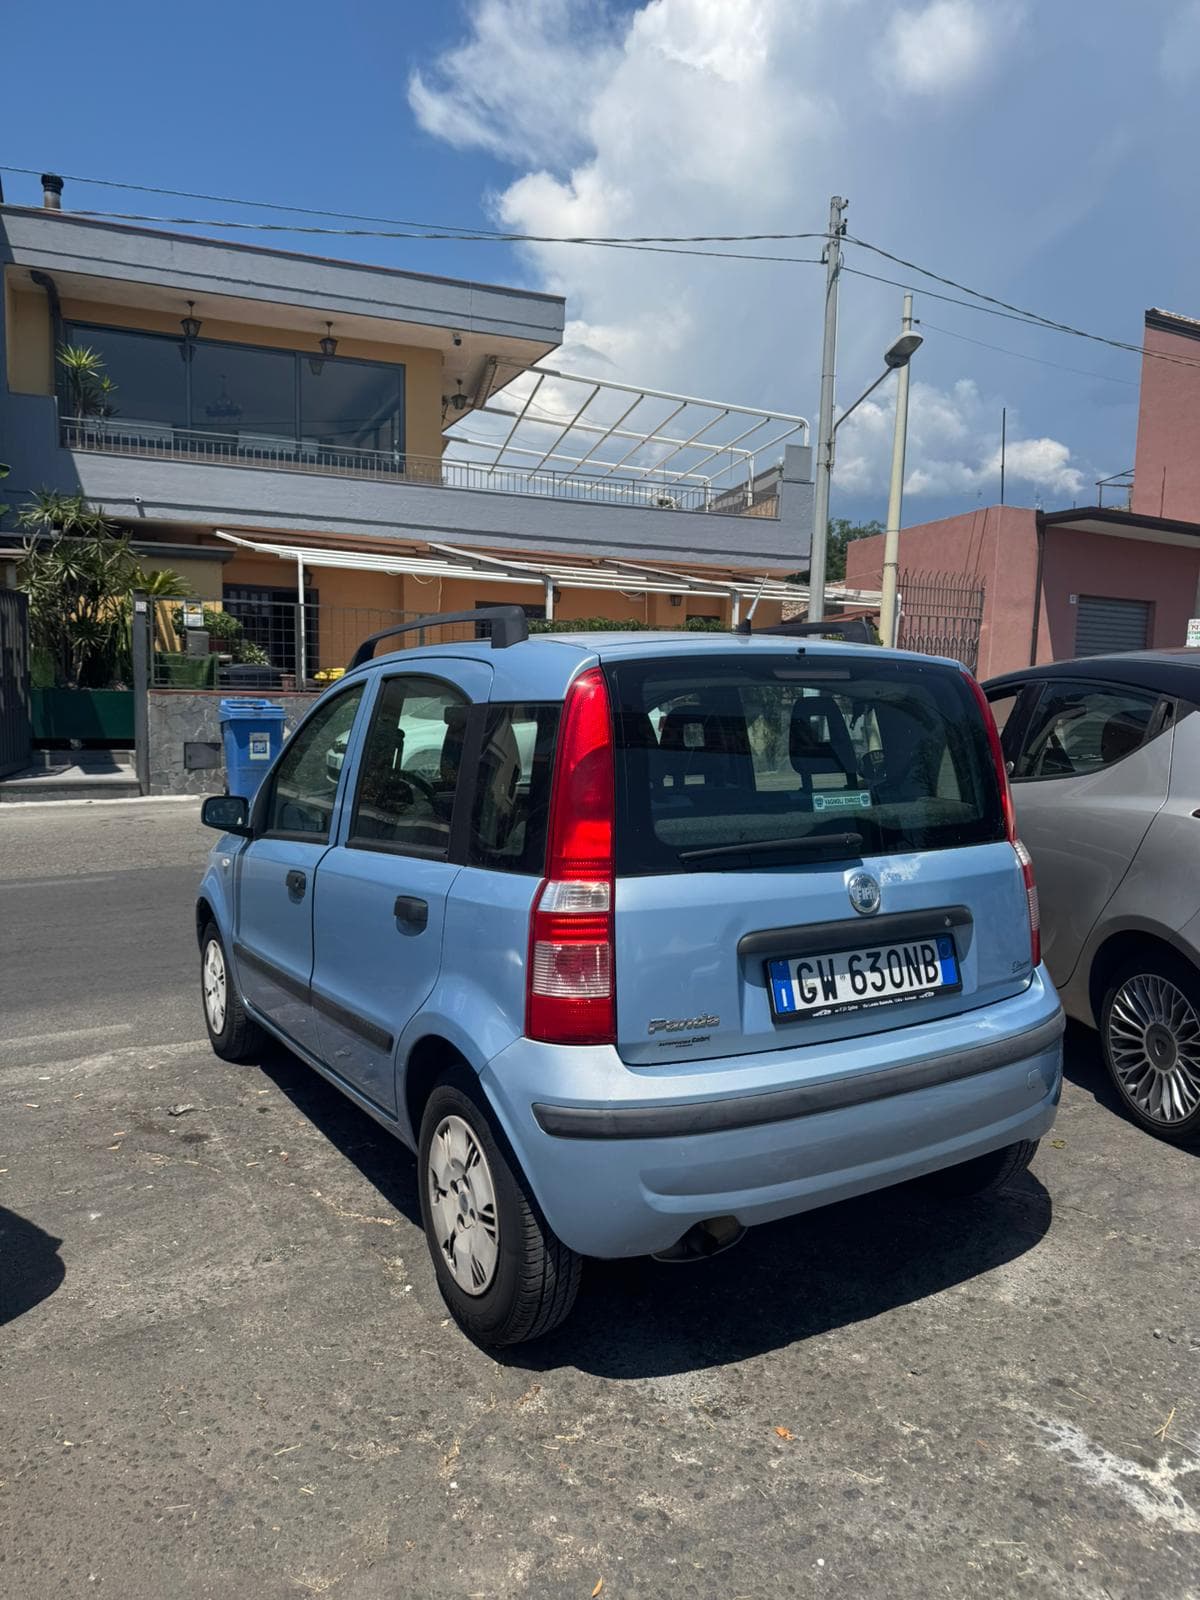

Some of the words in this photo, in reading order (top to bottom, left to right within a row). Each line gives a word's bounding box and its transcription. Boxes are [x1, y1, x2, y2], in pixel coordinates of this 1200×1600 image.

[796, 958, 838, 1004] GW
[847, 943, 939, 995] 630NB
[648, 1014, 720, 1035] Panda
